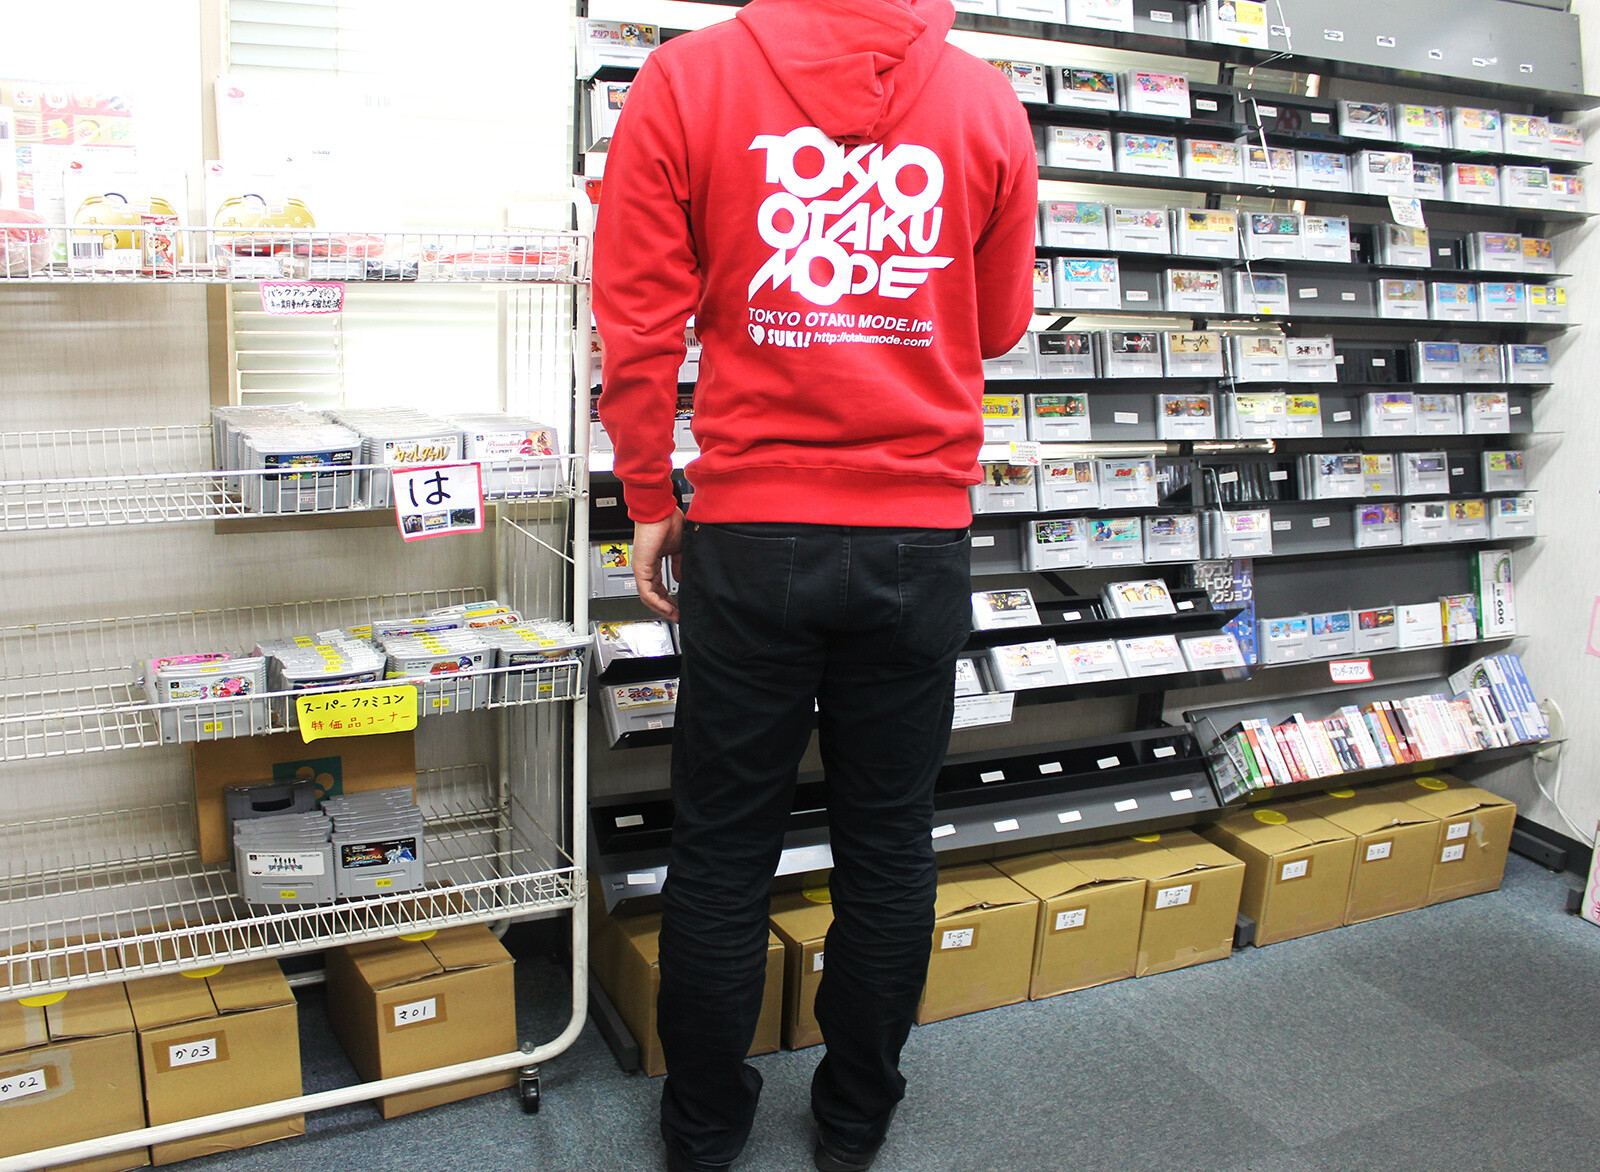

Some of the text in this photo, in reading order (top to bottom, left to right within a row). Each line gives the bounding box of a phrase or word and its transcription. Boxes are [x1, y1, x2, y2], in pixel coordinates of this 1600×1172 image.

[748, 126, 944, 214] TOKYO
[757, 192, 943, 254] OTAKU
[748, 238, 955, 306] MODE
[749, 307, 801, 326] TOKYO
[805, 312, 855, 328] OTAKU
[767, 329, 934, 348] SUKI! http://otakumode.com/
[409, 471, 451, 507] は
[311, 713, 410, 730] 特価品コーナー
